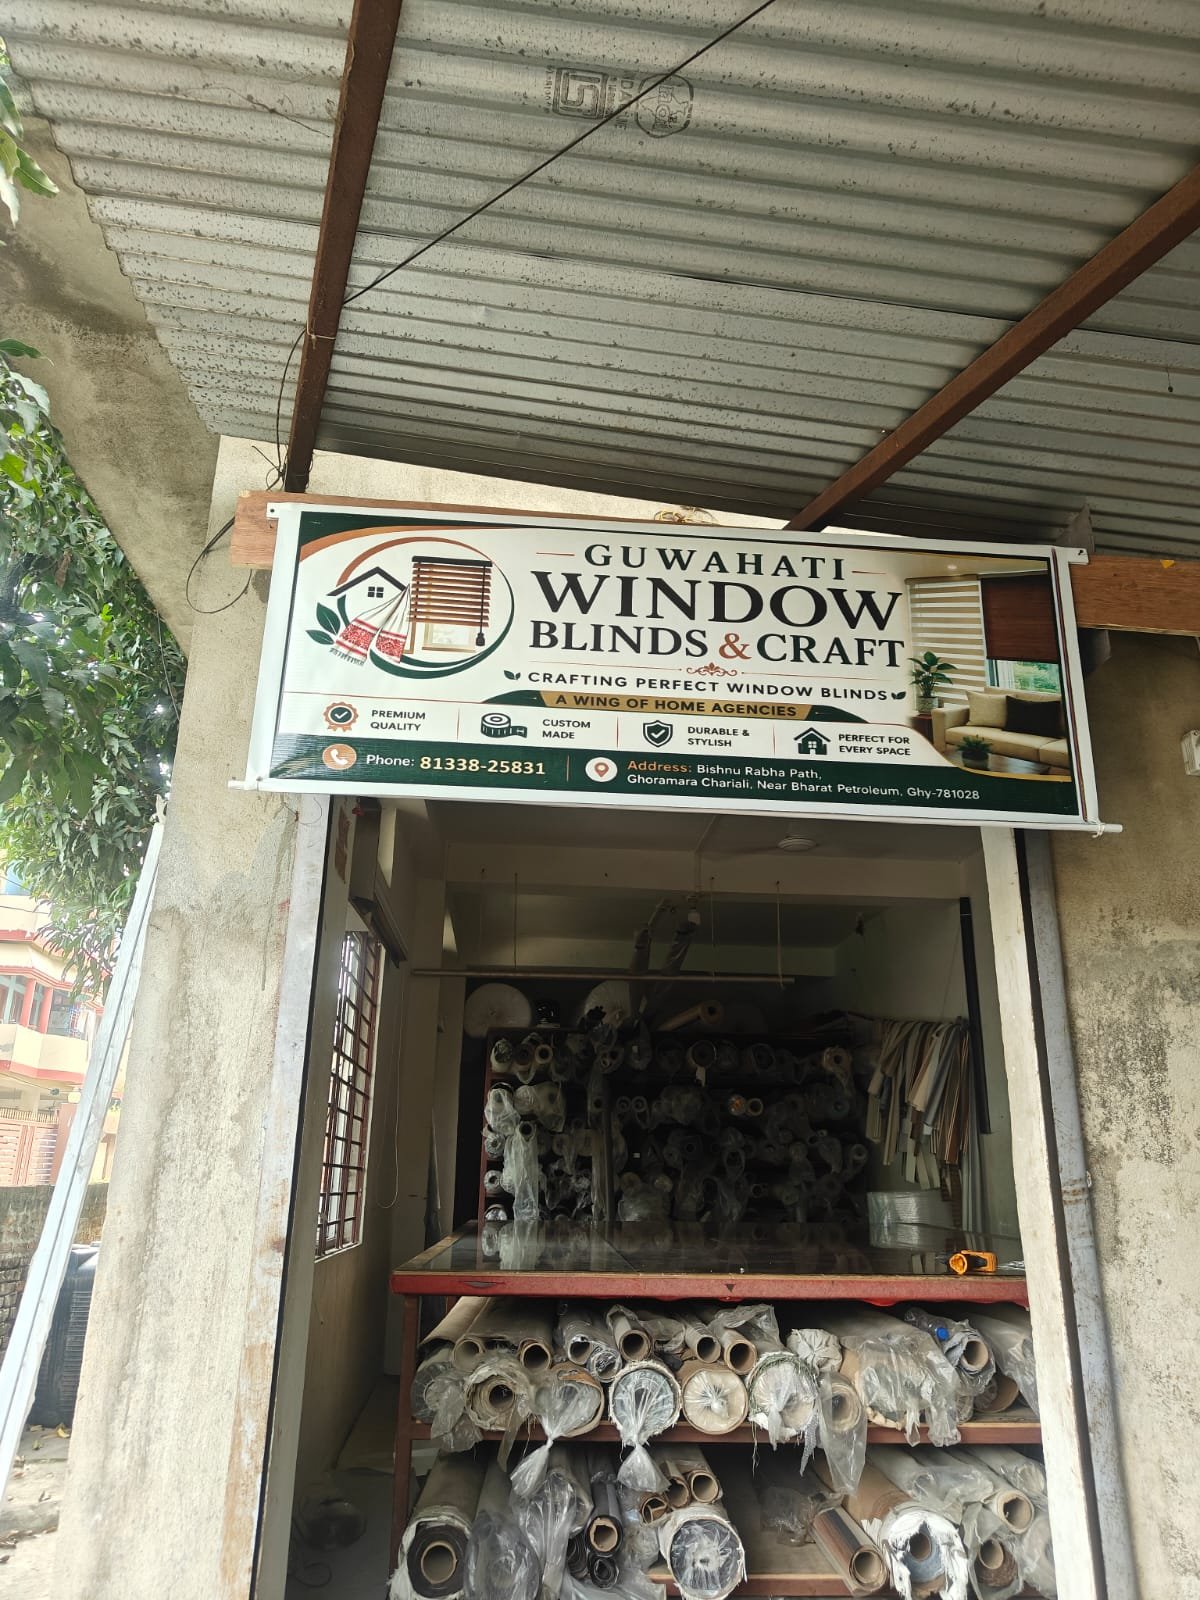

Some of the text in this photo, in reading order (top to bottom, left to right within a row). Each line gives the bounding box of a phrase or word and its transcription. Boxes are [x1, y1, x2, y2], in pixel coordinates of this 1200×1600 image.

[584, 544, 845, 580] GUWAHATI
[531, 571, 902, 631] WINDOW
[529, 620, 905, 668] BLINDS & CRAFT
[528, 672, 888, 701] CRAFTING PERFECT WINDOW BLINDS
[555, 694, 796, 717] A WING OF HOME AGENCIES
[371, 709, 426, 720] PREMIUM
[370, 721, 421, 732] QUALITY
[542, 718, 591, 729] CUSTOM
[542, 729, 575, 740] MADE
[687, 726, 750, 737] DURABLE &
[838, 733, 910, 744] PERFECT FOR
[687, 737, 732, 747] STYLISH
[839, 745, 911, 756] EVERY SPACE
[366, 754, 545, 775] Phone: 81338-25831
[627, 760, 822, 780] Address: Bishnu Rabha Path,
[627, 774, 698, 786] Ghoramara
[757, 780, 788, 791] Near
[791, 781, 833, 793] Bharat
[907, 786, 980, 800] Ghy-781028
